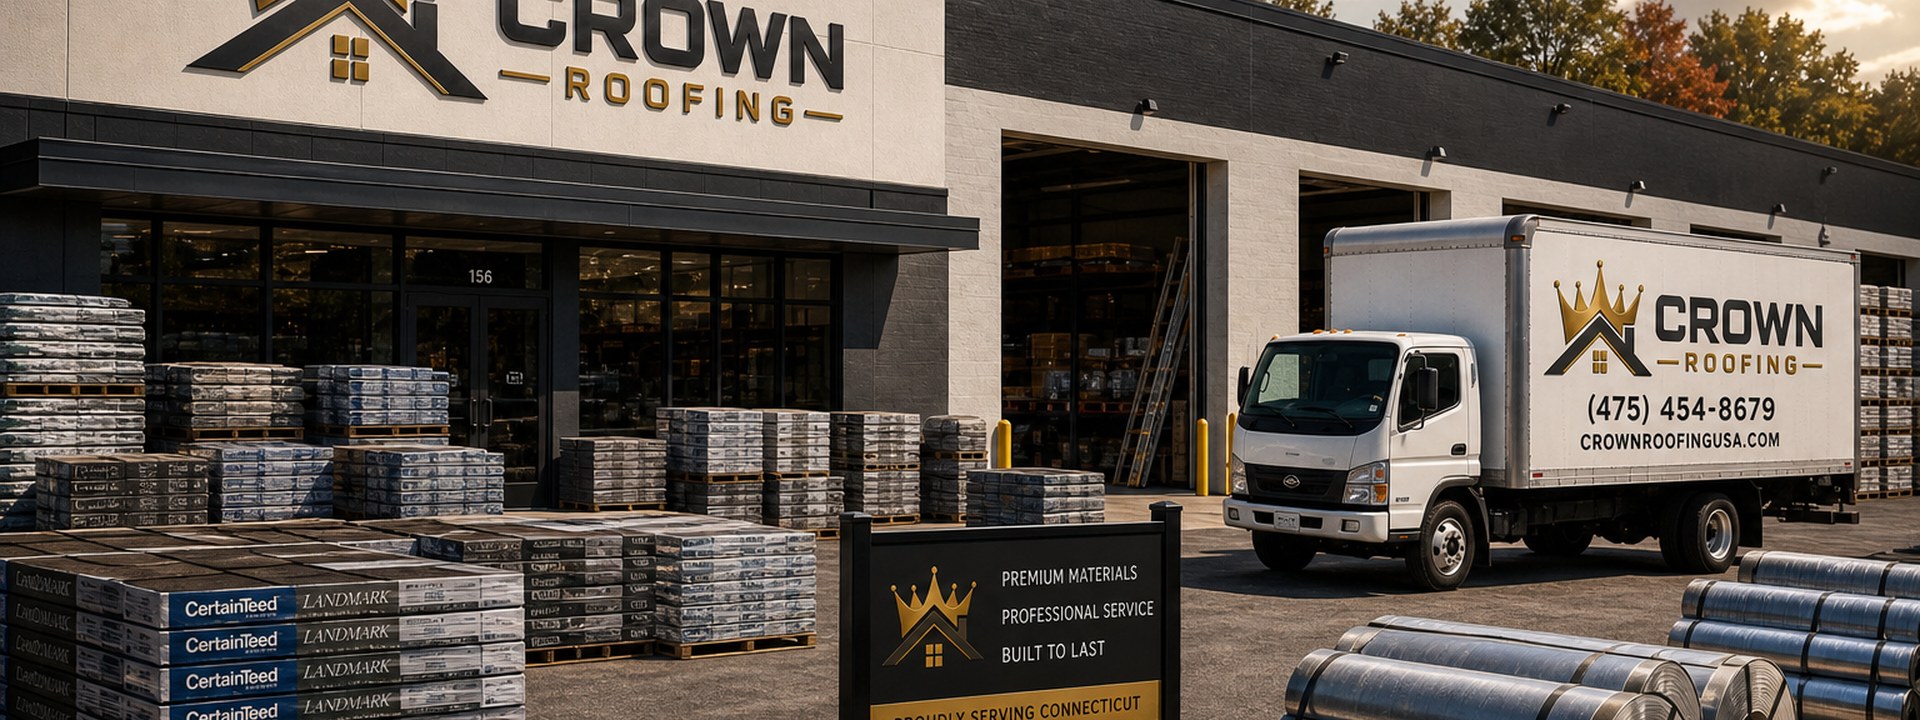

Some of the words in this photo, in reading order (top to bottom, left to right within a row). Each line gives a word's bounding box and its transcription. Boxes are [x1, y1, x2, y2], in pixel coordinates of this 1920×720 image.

[499, 0, 844, 91] CROWN
[565, 66, 794, 125] ROOFING
[468, 269, 493, 284] 156
[1655, 294, 1823, 348] CROWN
[1685, 352, 1797, 375] ROOFING
[1587, 394, 1650, 426] (475)
[1660, 396, 1775, 421] 454-8679
[1580, 432, 1780, 451] CROWNROOFINGUSA.COM
[1002, 569, 1064, 587] PREMIUM
[1068, 565, 1138, 583] MATERIALS
[185, 596, 278, 617] CertainTeed
[302, 589, 391, 609] LANDMARK
[1002, 604, 1100, 625] PROFESSIONAL
[1103, 600, 1154, 619] SERVICE
[185, 631, 278, 653] CertainTeed
[303, 624, 391, 645] LANDMARK
[1002, 645, 1041, 663] BUILT
[1047, 643, 1067, 660] TO
[1071, 640, 1105, 658] LAST
[186, 667, 278, 690] CertainTeed
[303, 659, 392, 680] LANDMARK
[304, 693, 392, 715] LANDMARK
[971, 705, 1035, 720] SERVING
[1040, 696, 1141, 719] CONNECTICUT
